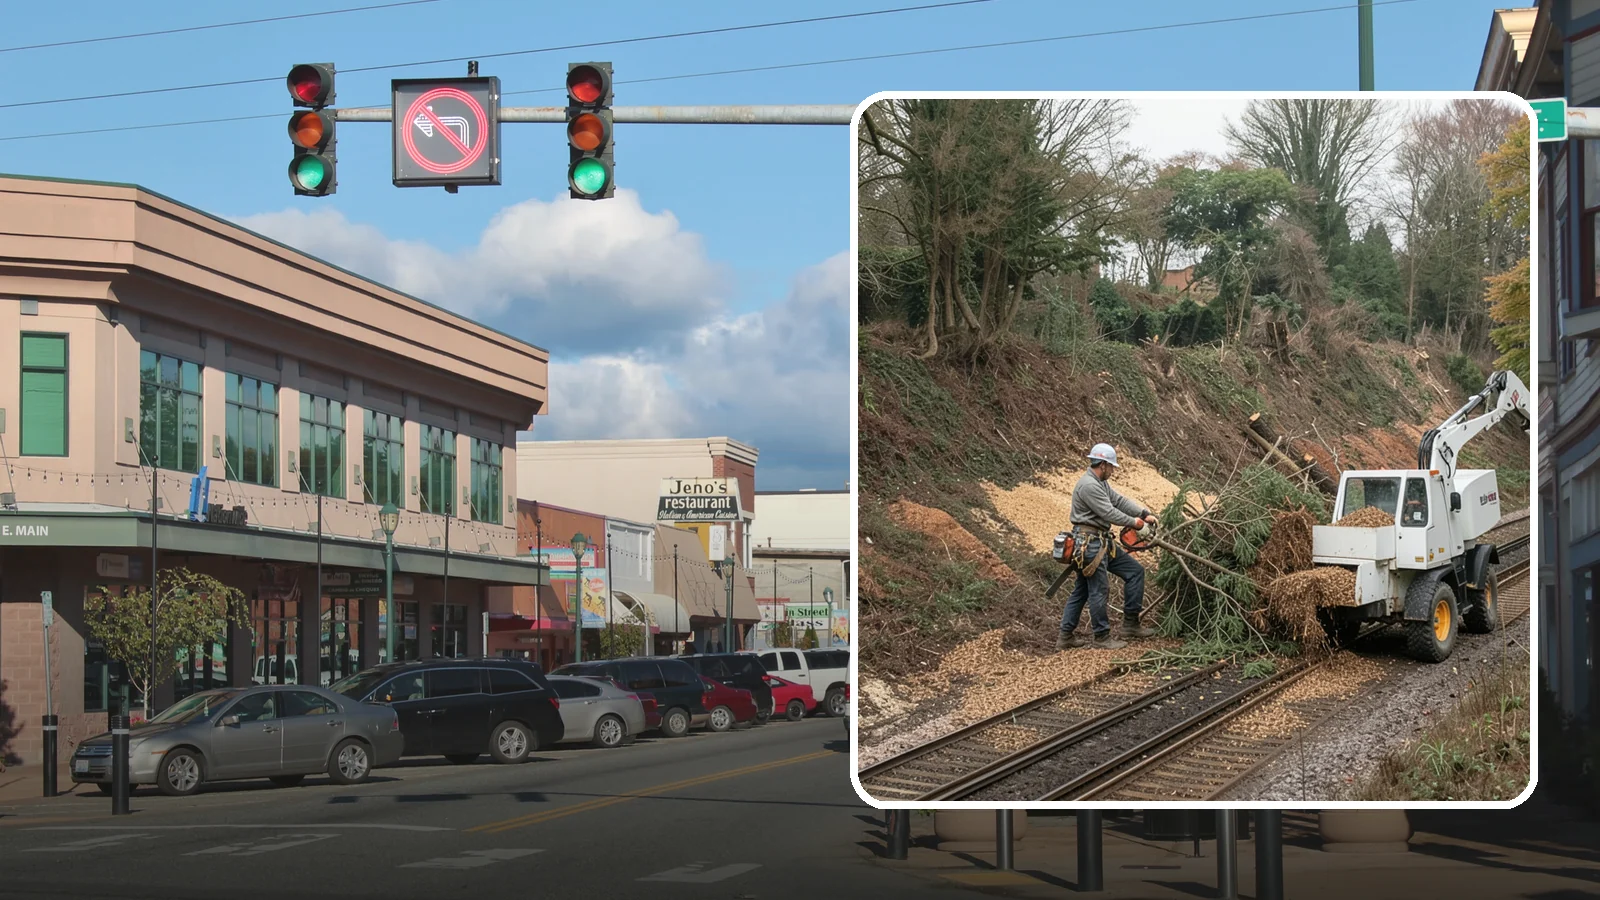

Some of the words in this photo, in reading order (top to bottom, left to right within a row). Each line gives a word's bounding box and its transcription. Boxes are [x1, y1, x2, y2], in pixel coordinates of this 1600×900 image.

[669, 480, 727, 494] Jeno's
[665, 497, 730, 509] restaurant
[659, 510, 681, 520] Italian
[686, 510, 714, 519] American
[715, 510, 737, 519] Cuisine
[2, 525, 13, 536] E.
[15, 525, 49, 536] MAIN
[797, 607, 828, 617] Street
[791, 619, 824, 627] lass
